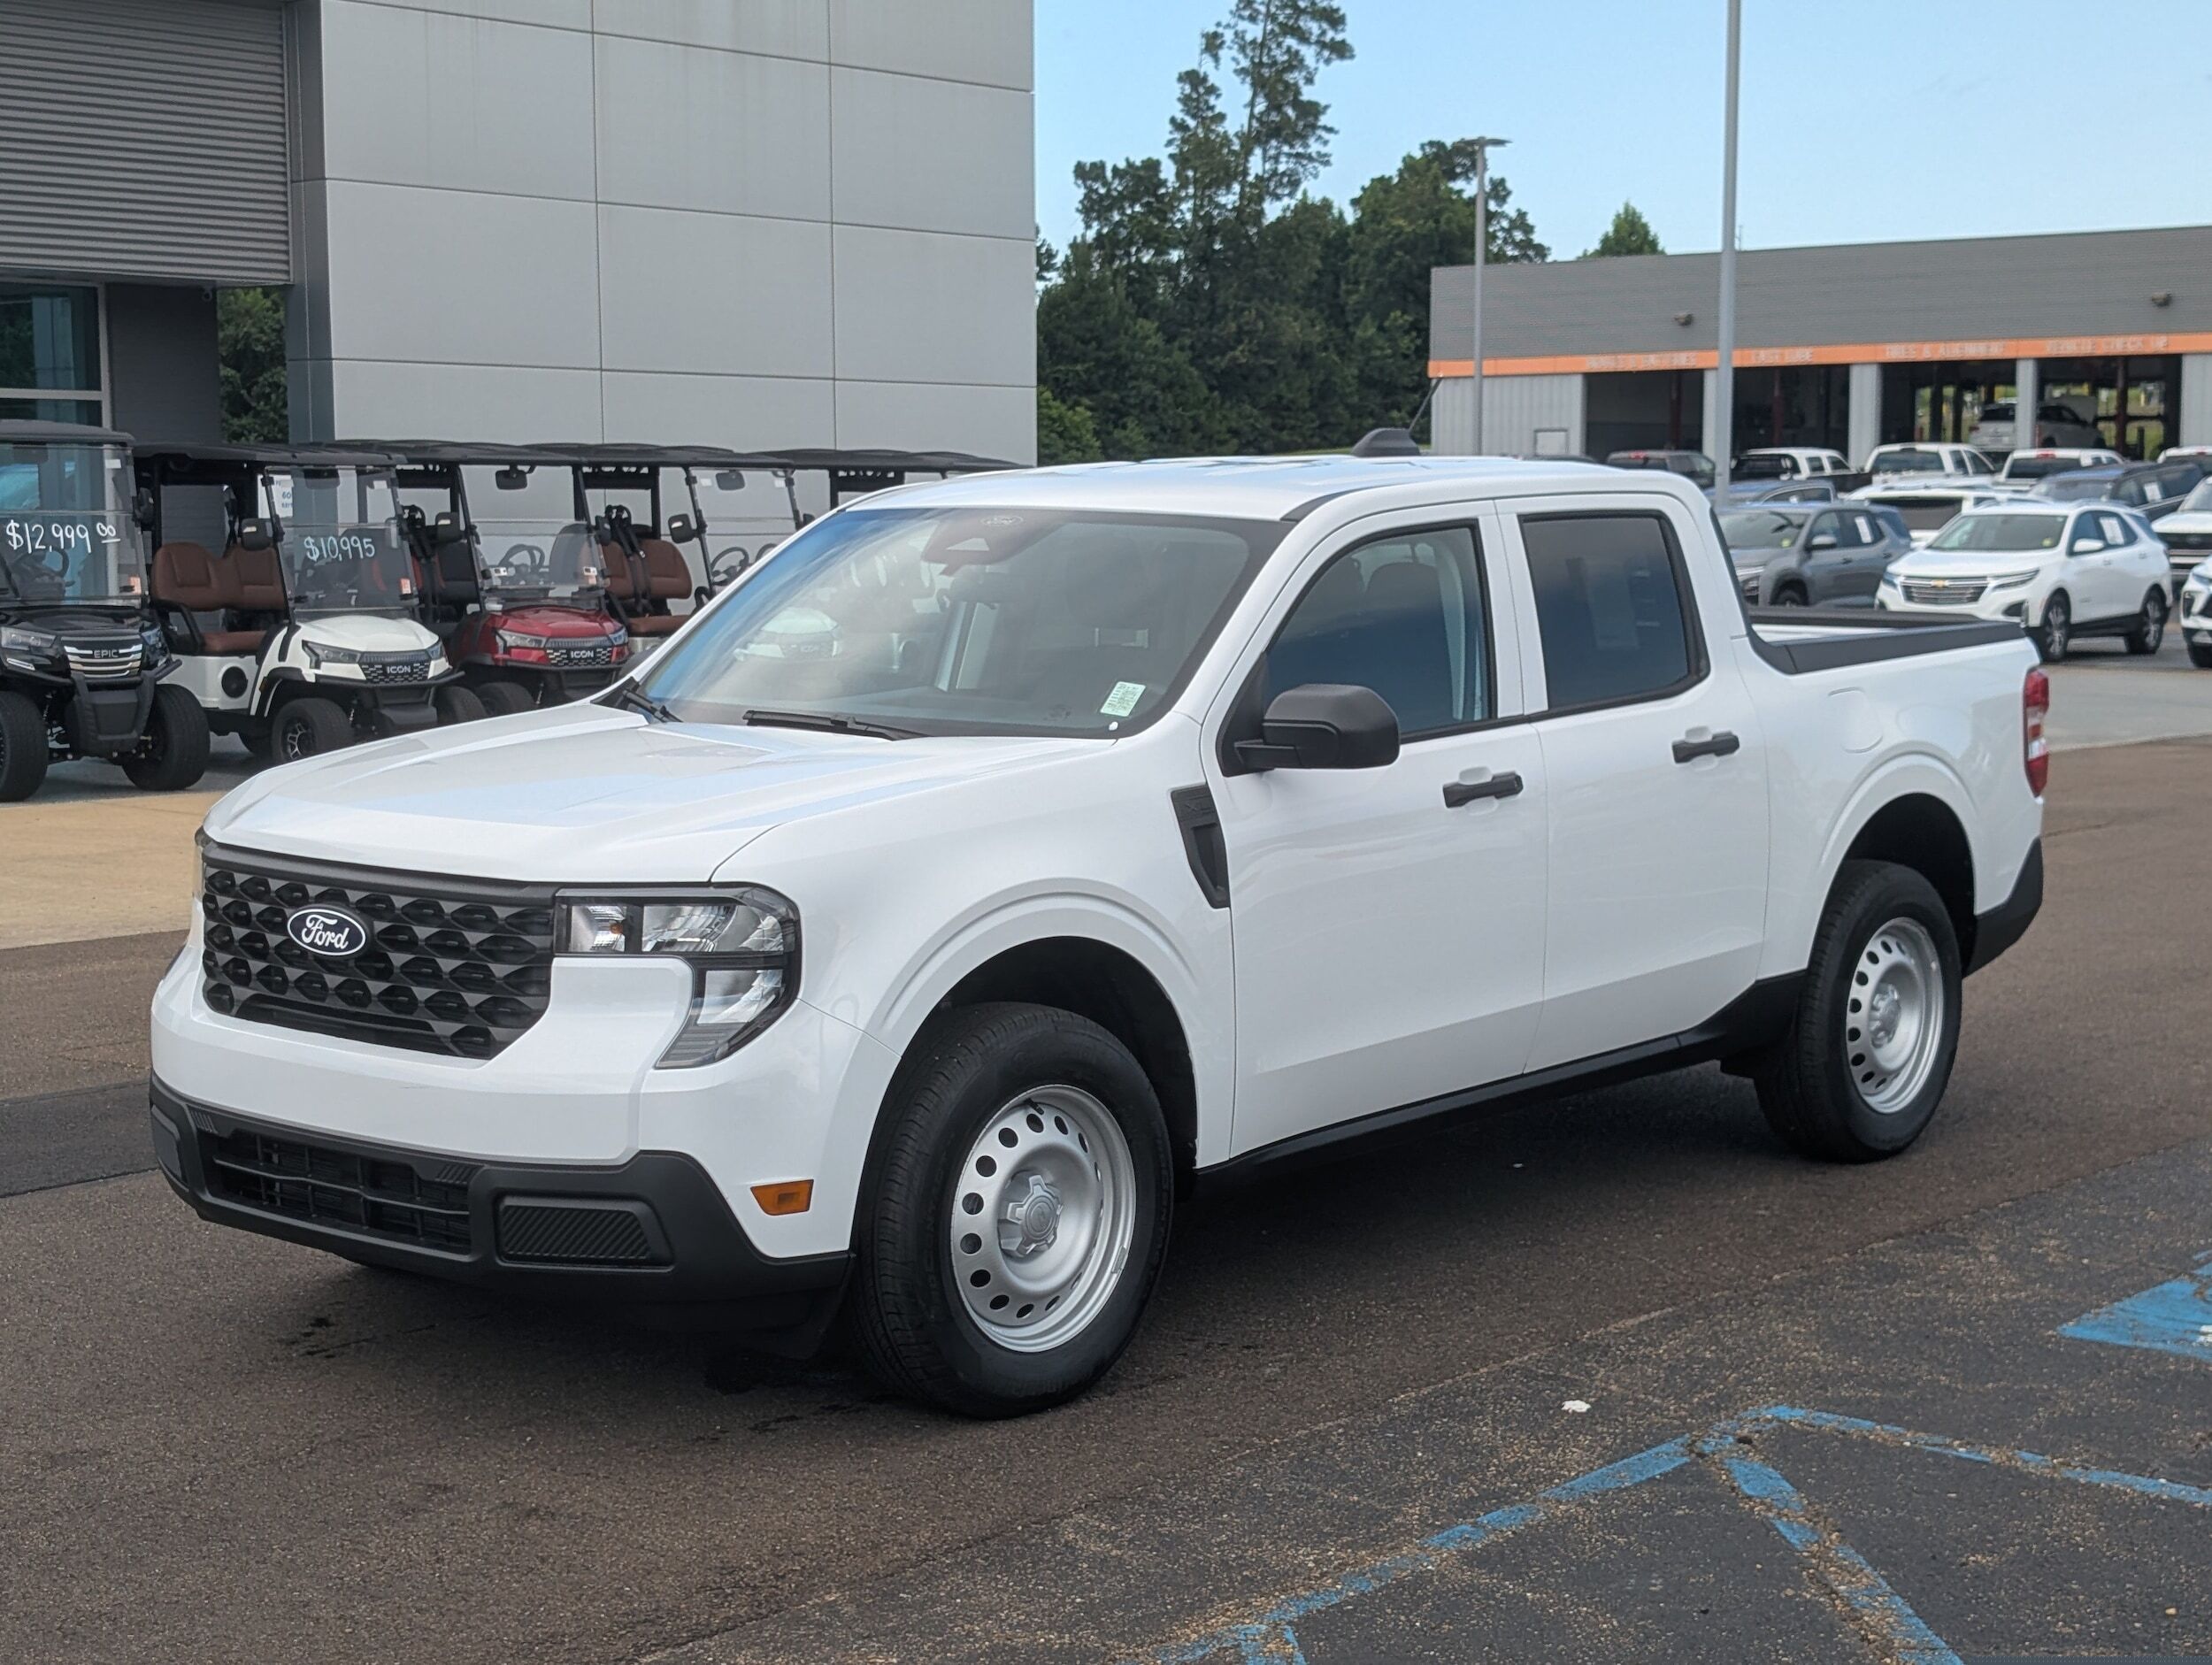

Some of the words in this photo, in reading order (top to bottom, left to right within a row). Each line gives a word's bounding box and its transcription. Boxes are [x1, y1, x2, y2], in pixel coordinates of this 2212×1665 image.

[6, 519, 91, 554] $12,999
[303, 536, 375, 561] $10,995
[93, 649, 119, 658] EPIC
[387, 665, 411, 674] ICON
[301, 914, 349, 949] Ford
